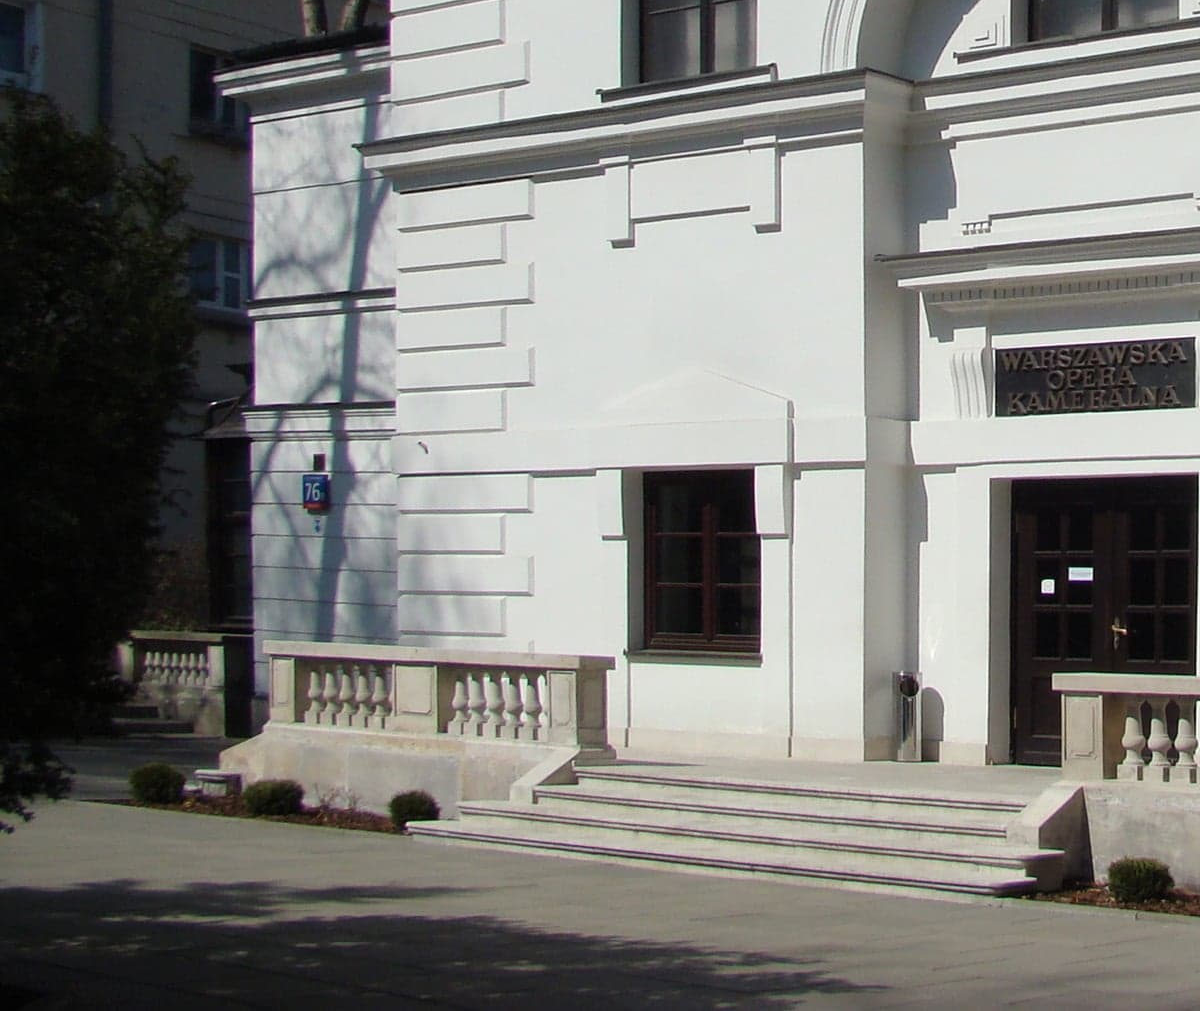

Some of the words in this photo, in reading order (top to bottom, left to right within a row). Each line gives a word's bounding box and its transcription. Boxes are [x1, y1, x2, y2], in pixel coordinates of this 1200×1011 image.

[1001, 341, 1187, 371] WARSZAWSKA
[1048, 366, 1136, 390] OPERA
[1008, 384, 1181, 415] KAMERALNA
